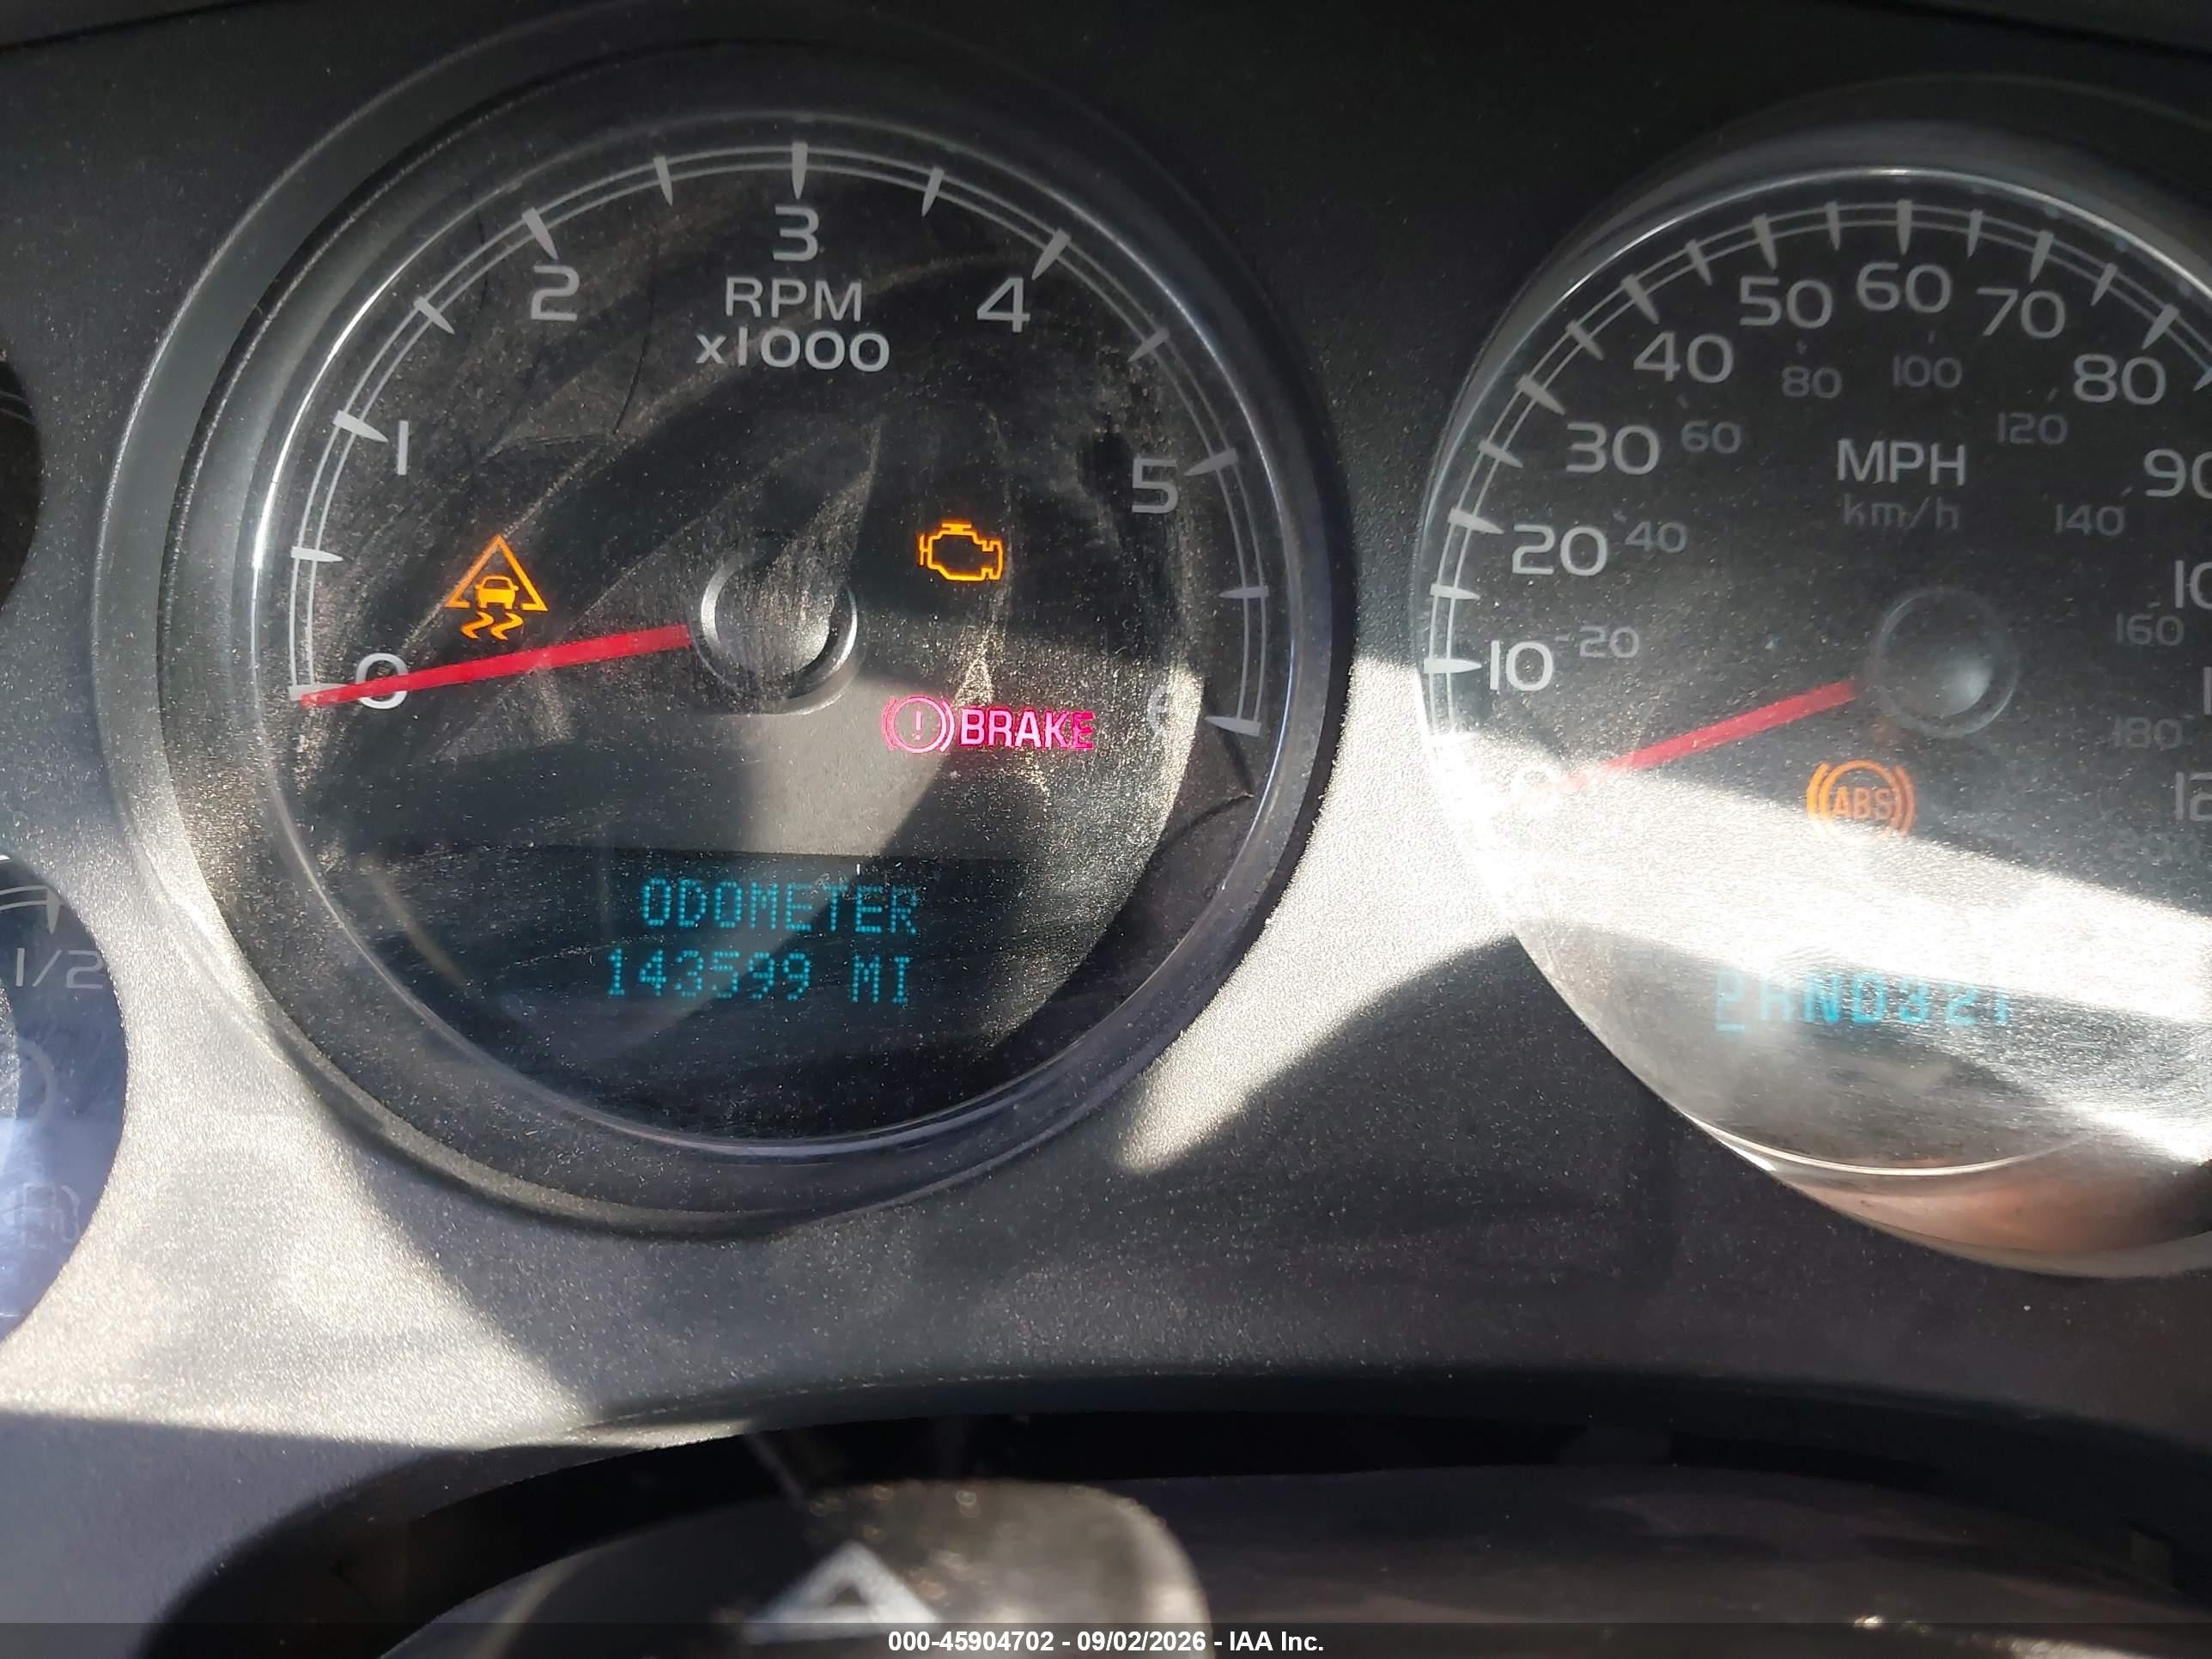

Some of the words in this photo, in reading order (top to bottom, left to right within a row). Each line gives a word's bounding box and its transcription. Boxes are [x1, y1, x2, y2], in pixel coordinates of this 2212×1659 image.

[774, 205, 819, 262] 3
[530, 265, 580, 321] 2
[726, 277, 862, 320] RPM
[977, 276, 1030, 332] 4
[1740, 276, 1833, 329] 50
[1856, 264, 1953, 313] 60
[1977, 286, 2065, 339] 70
[696, 327, 890, 372] x1000
[1633, 331, 1734, 383] 40
[1893, 356, 1963, 389] 100
[1782, 367, 1843, 399] 80
[2073, 355, 2166, 405] 80
[398, 421, 409, 476] 1
[1565, 422, 1661, 475] 30
[1680, 422, 1742, 455] 60
[1997, 413, 2067, 446] 120
[1131, 459, 1178, 514] 5
[1836, 439, 1967, 486] MPH
[1843, 494, 1960, 529] km/h
[2054, 503, 2125, 537] 140
[1512, 525, 1608, 576] 20
[1625, 522, 1688, 554] 40
[1578, 625, 1640, 659] 20
[2116, 613, 2184, 647] 160
[356, 653, 408, 709] 0
[1490, 641, 1553, 691] 10
[960, 707, 1094, 750] BRAKE
[2112, 714, 2184, 749] 180
[1833, 786, 1893, 821] ABS
[641, 878, 919, 935] ODOMETER
[15, 947, 105, 989] 1/2
[606, 947, 811, 1002] 143599
[852, 955, 908, 1004] MI
